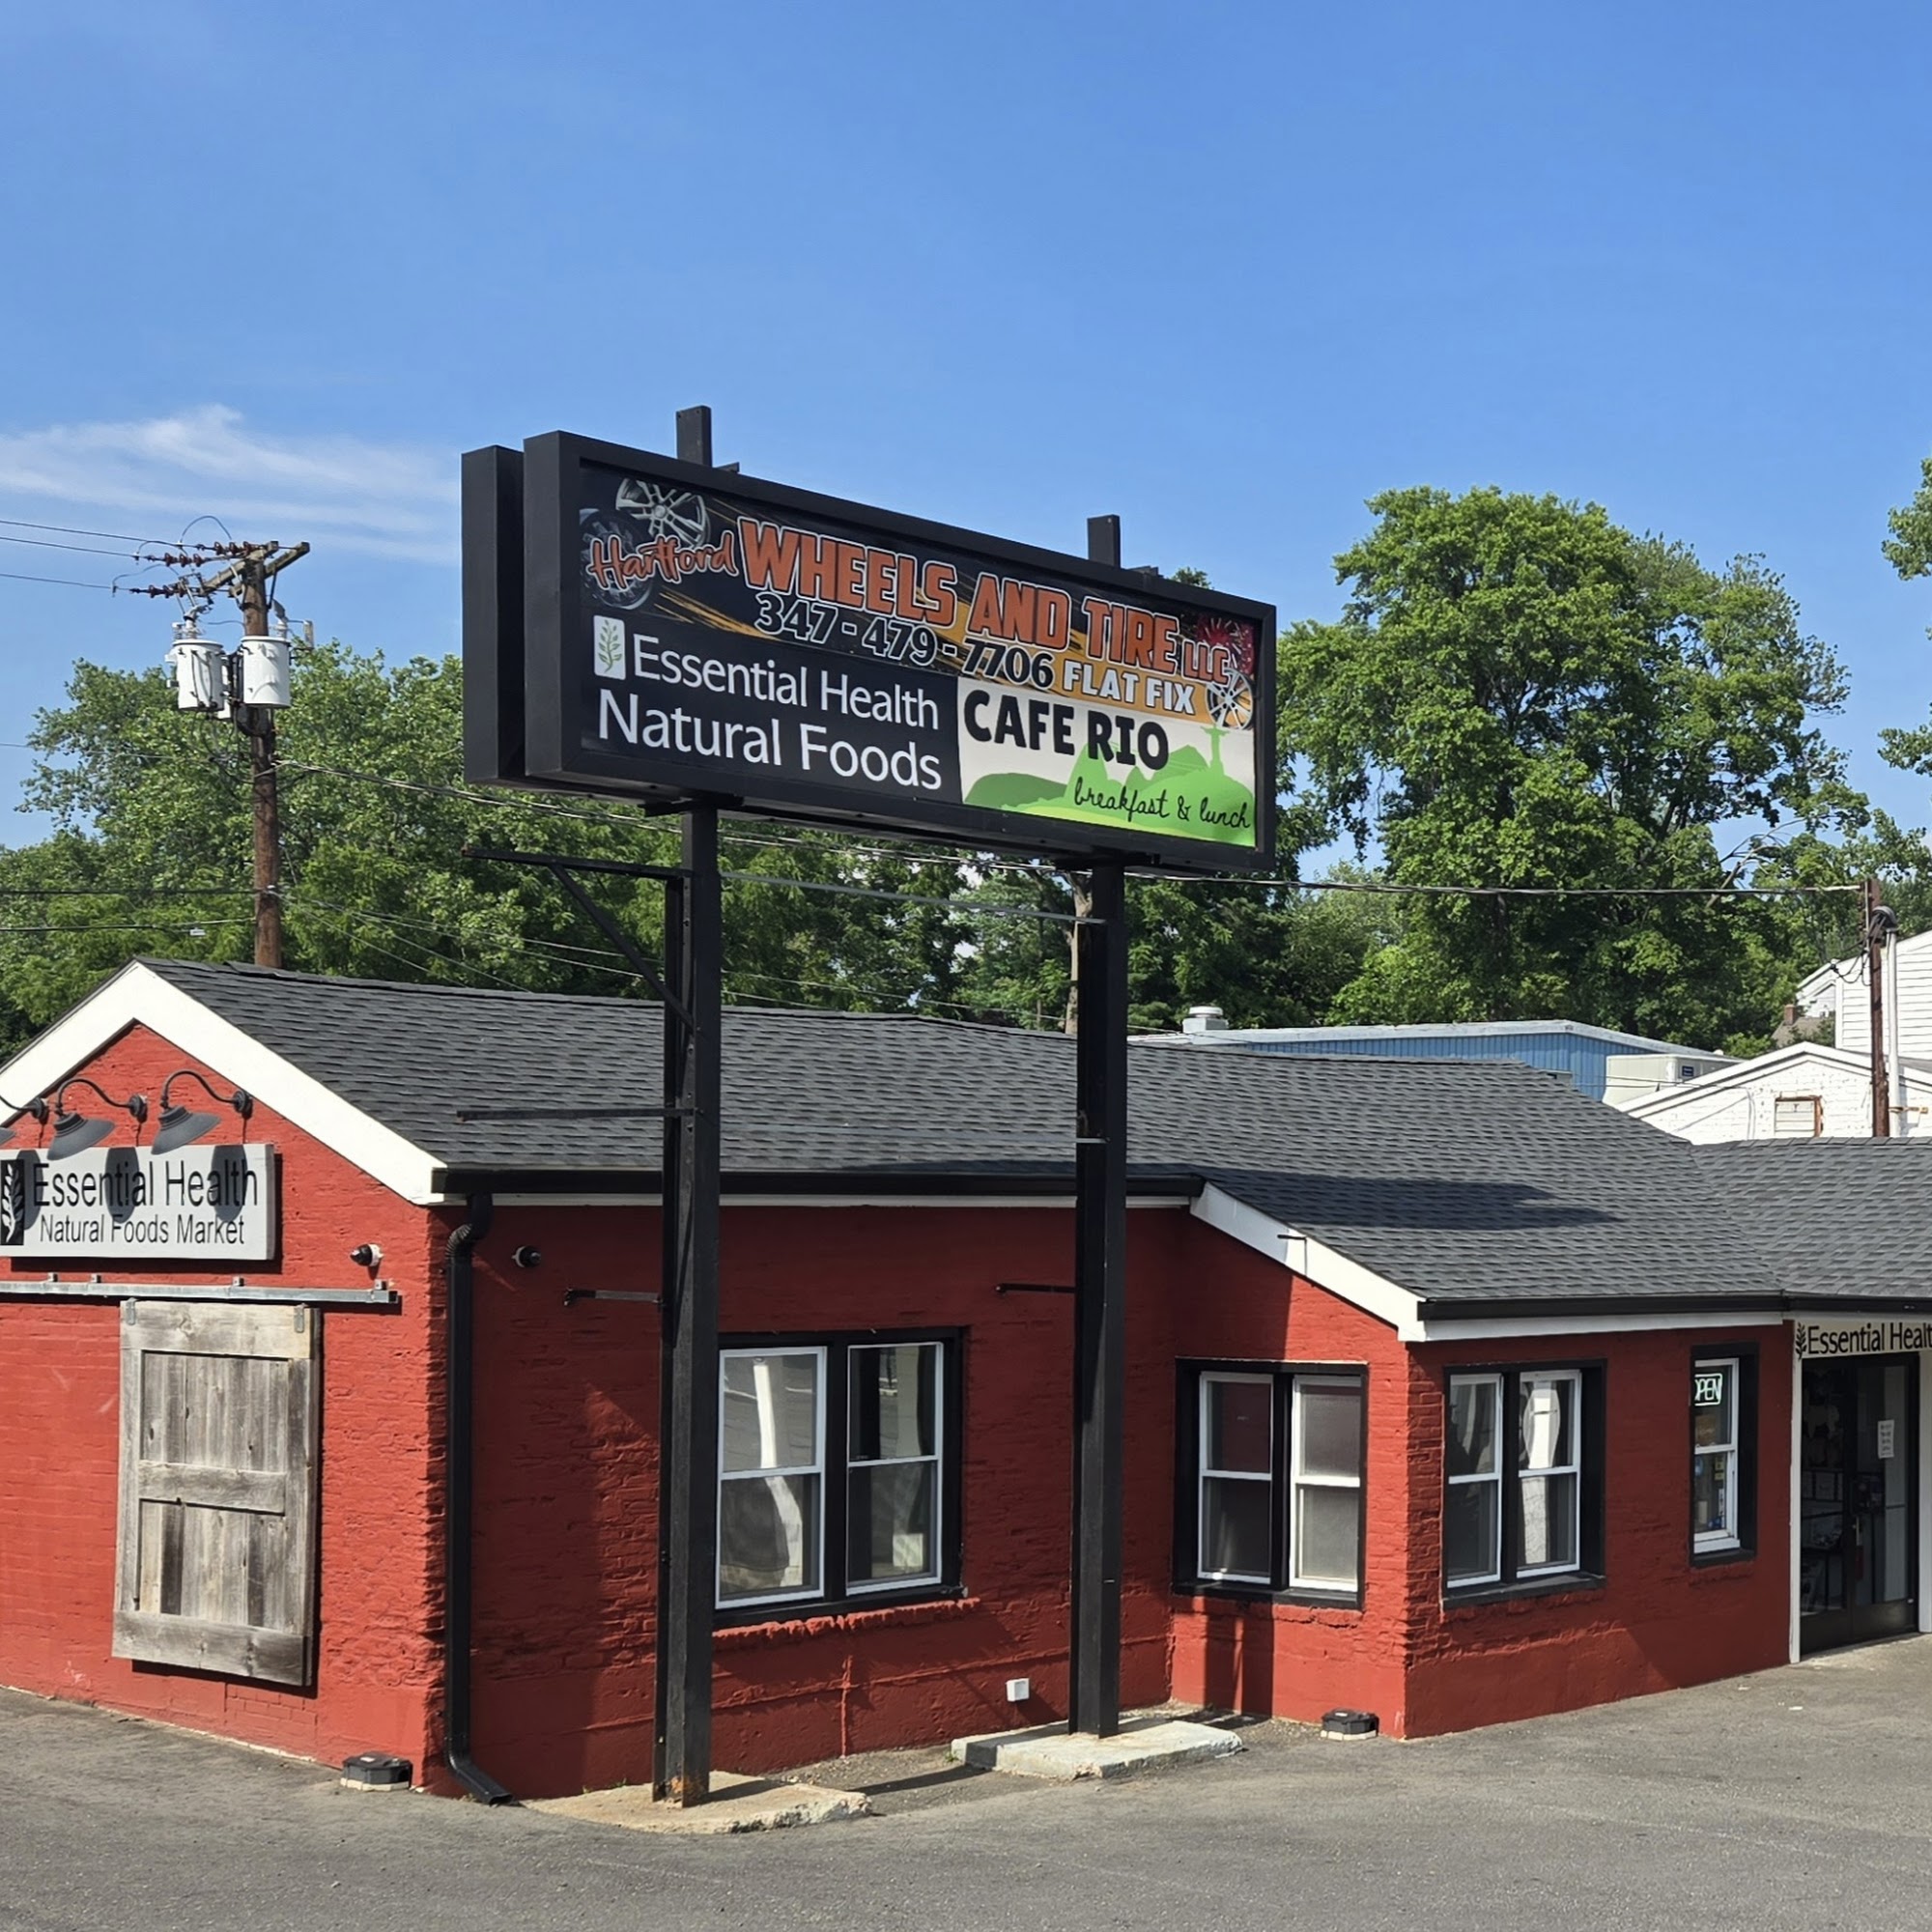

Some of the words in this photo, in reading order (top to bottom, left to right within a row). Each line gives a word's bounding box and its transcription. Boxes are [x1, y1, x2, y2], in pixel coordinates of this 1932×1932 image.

[589, 530, 740, 591] Hartford
[738, 516, 958, 628] WHEELS
[966, 572, 1072, 651] AND
[1082, 597, 1179, 675] TIRE
[1181, 639, 1232, 685] LLC
[633, 633, 808, 707] Essential
[821, 670, 939, 730] Health
[1064, 661, 1141, 703] FLAT
[1145, 679, 1195, 715] FIX
[599, 689, 781, 766] Natural
[800, 724, 942, 790] Foods
[964, 690, 1075, 755] CAFE
[1088, 710, 1169, 771] RIO
[1074, 777, 1170, 822] breakfast
[1177, 796, 1192, 821] &
[1200, 798, 1251, 828] lunch
[34, 1161, 153, 1207] Essential
[165, 1161, 258, 1206] Health
[41, 1213, 104, 1243] Natural
[111, 1214, 169, 1243] Foods
[177, 1214, 245, 1244] Market
[1808, 1322, 1885, 1354] Essential
